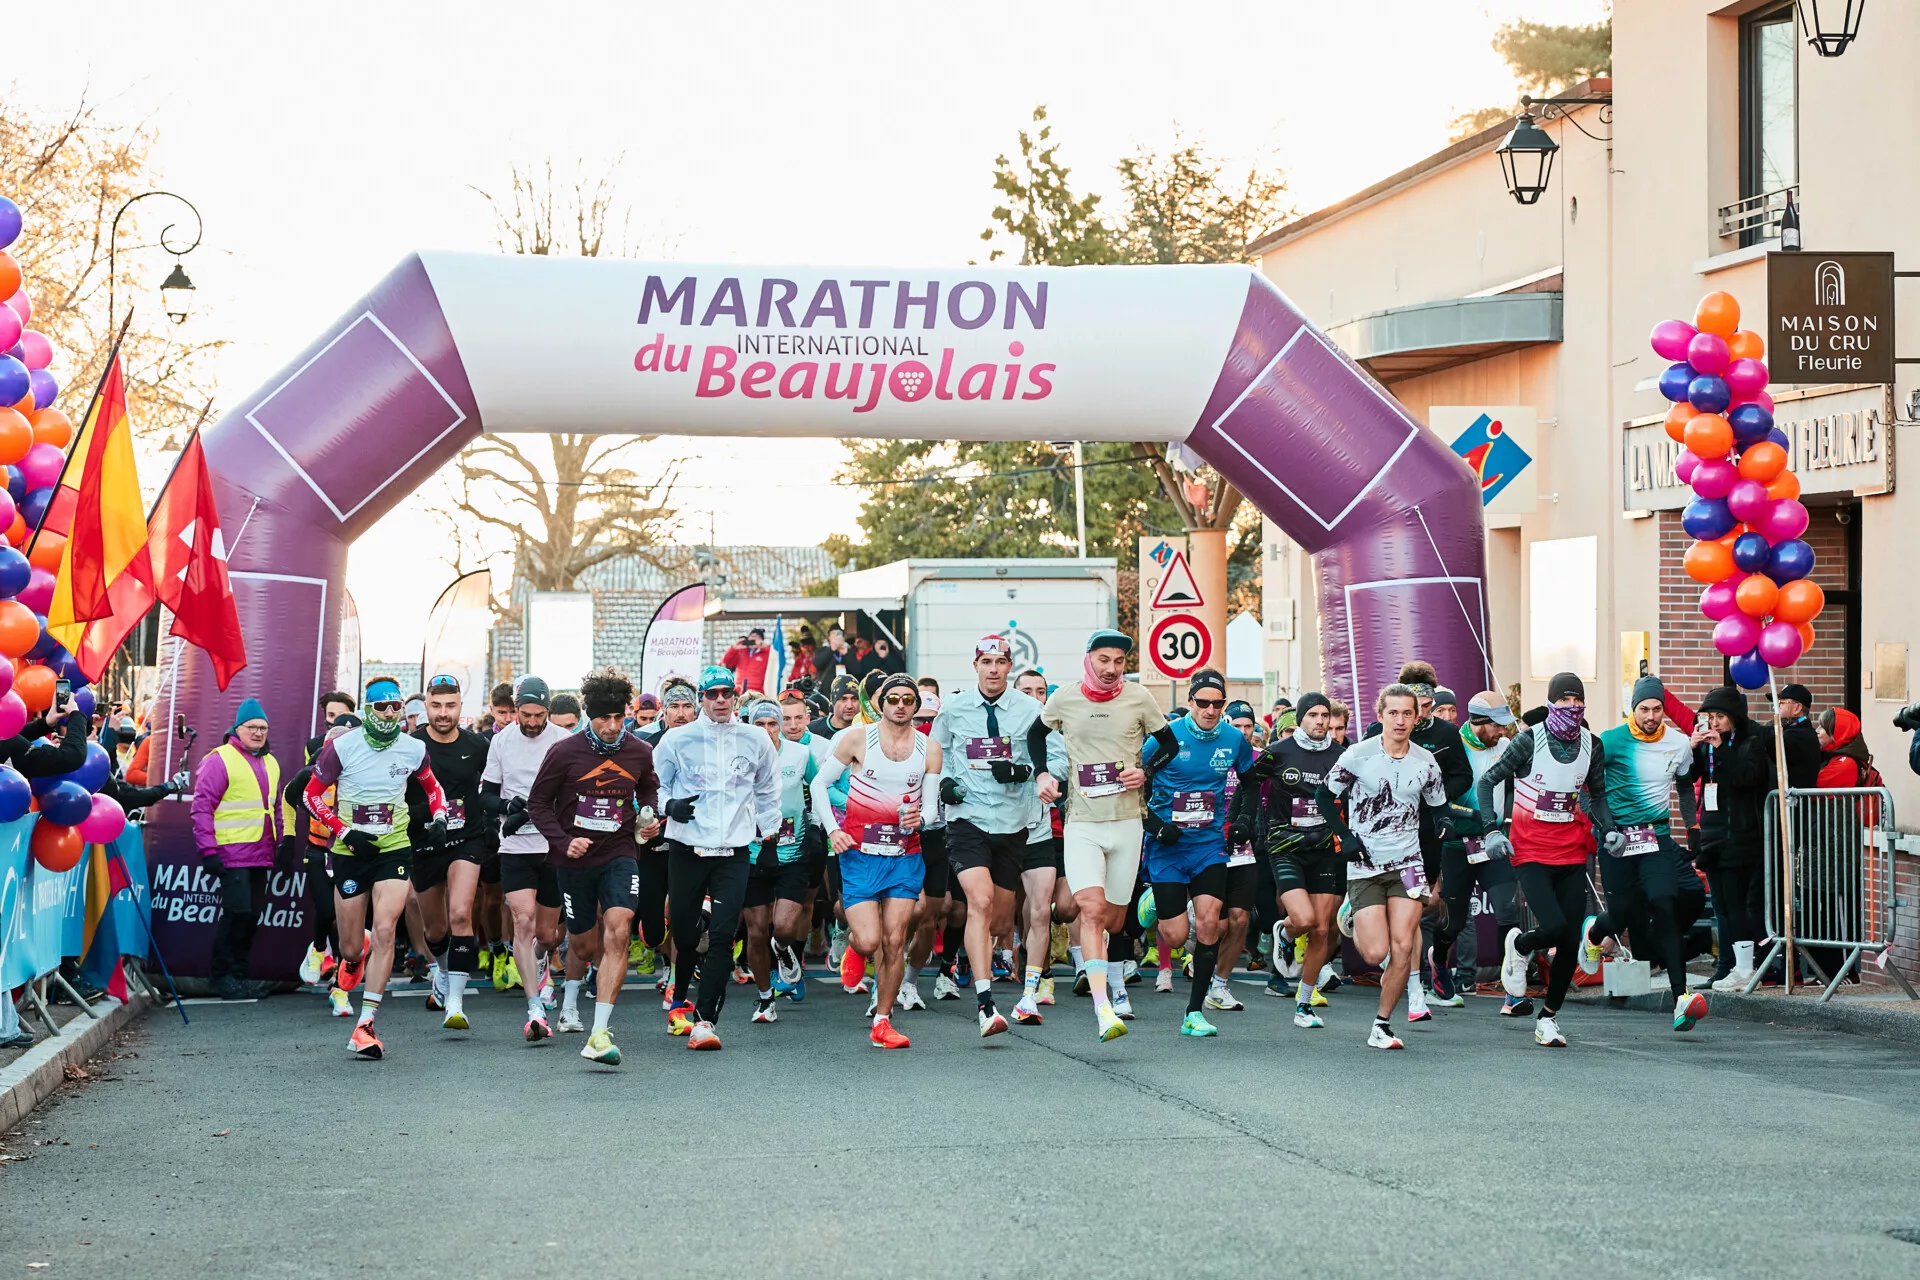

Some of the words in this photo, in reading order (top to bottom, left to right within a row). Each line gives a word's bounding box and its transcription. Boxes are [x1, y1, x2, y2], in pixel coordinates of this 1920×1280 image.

[637, 275, 1048, 330] MARATHON
[1781, 315, 1877, 331] MAISON
[737, 334, 929, 356] INTERNATIONAL
[1791, 335, 1819, 351] DU
[1829, 335, 1870, 351] CRU
[1798, 355, 1862, 370] Fleurie
[634, 333, 691, 372] du
[695, 340, 1057, 413] Beaujolais
[1630, 444, 1653, 491] LA
[1800, 408, 1877, 471] FLEURIE
[651, 637, 700, 647] MARATHON
[1162, 631, 1200, 660] 30
[986, 749, 992, 757] 3
[1095, 774, 1107, 783] 83
[1285, 772, 1299, 780] TDR
[1185, 802, 1205, 810] 3103
[1307, 807, 1318, 815] 84
[368, 814, 379, 822] 19
[593, 809, 606, 817] 42
[880, 835, 891, 843] 24
[1629, 834, 1641, 842] 80
[151, 892, 169, 910] du
